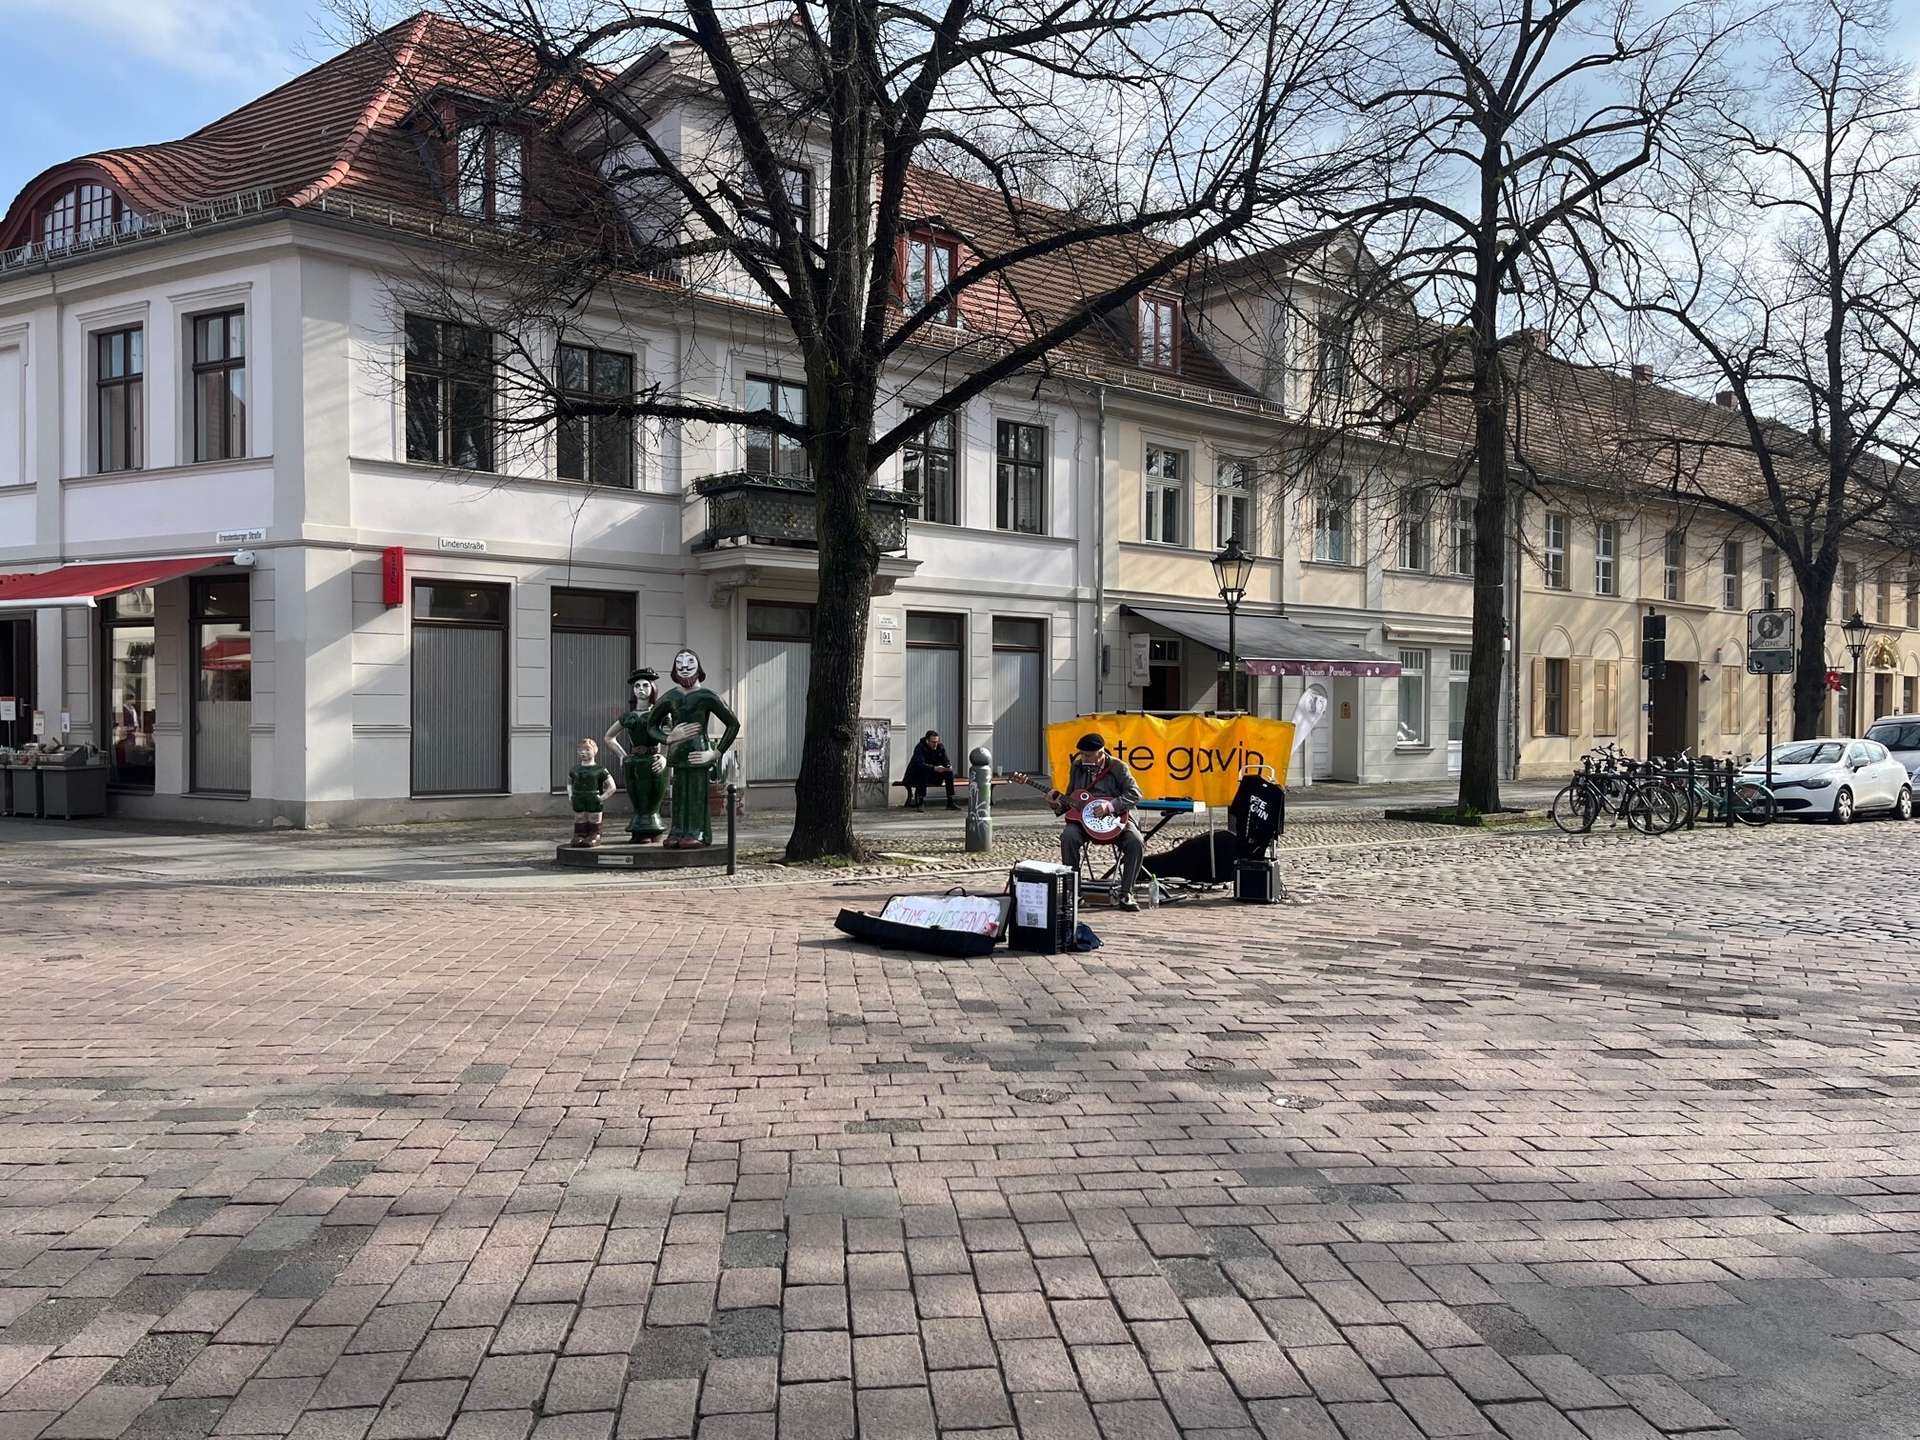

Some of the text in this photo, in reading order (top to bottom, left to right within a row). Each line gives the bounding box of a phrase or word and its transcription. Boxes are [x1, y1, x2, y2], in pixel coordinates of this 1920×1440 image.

[441, 538, 485, 550] Lindenstraße
[1069, 739, 1265, 781] te gavin
